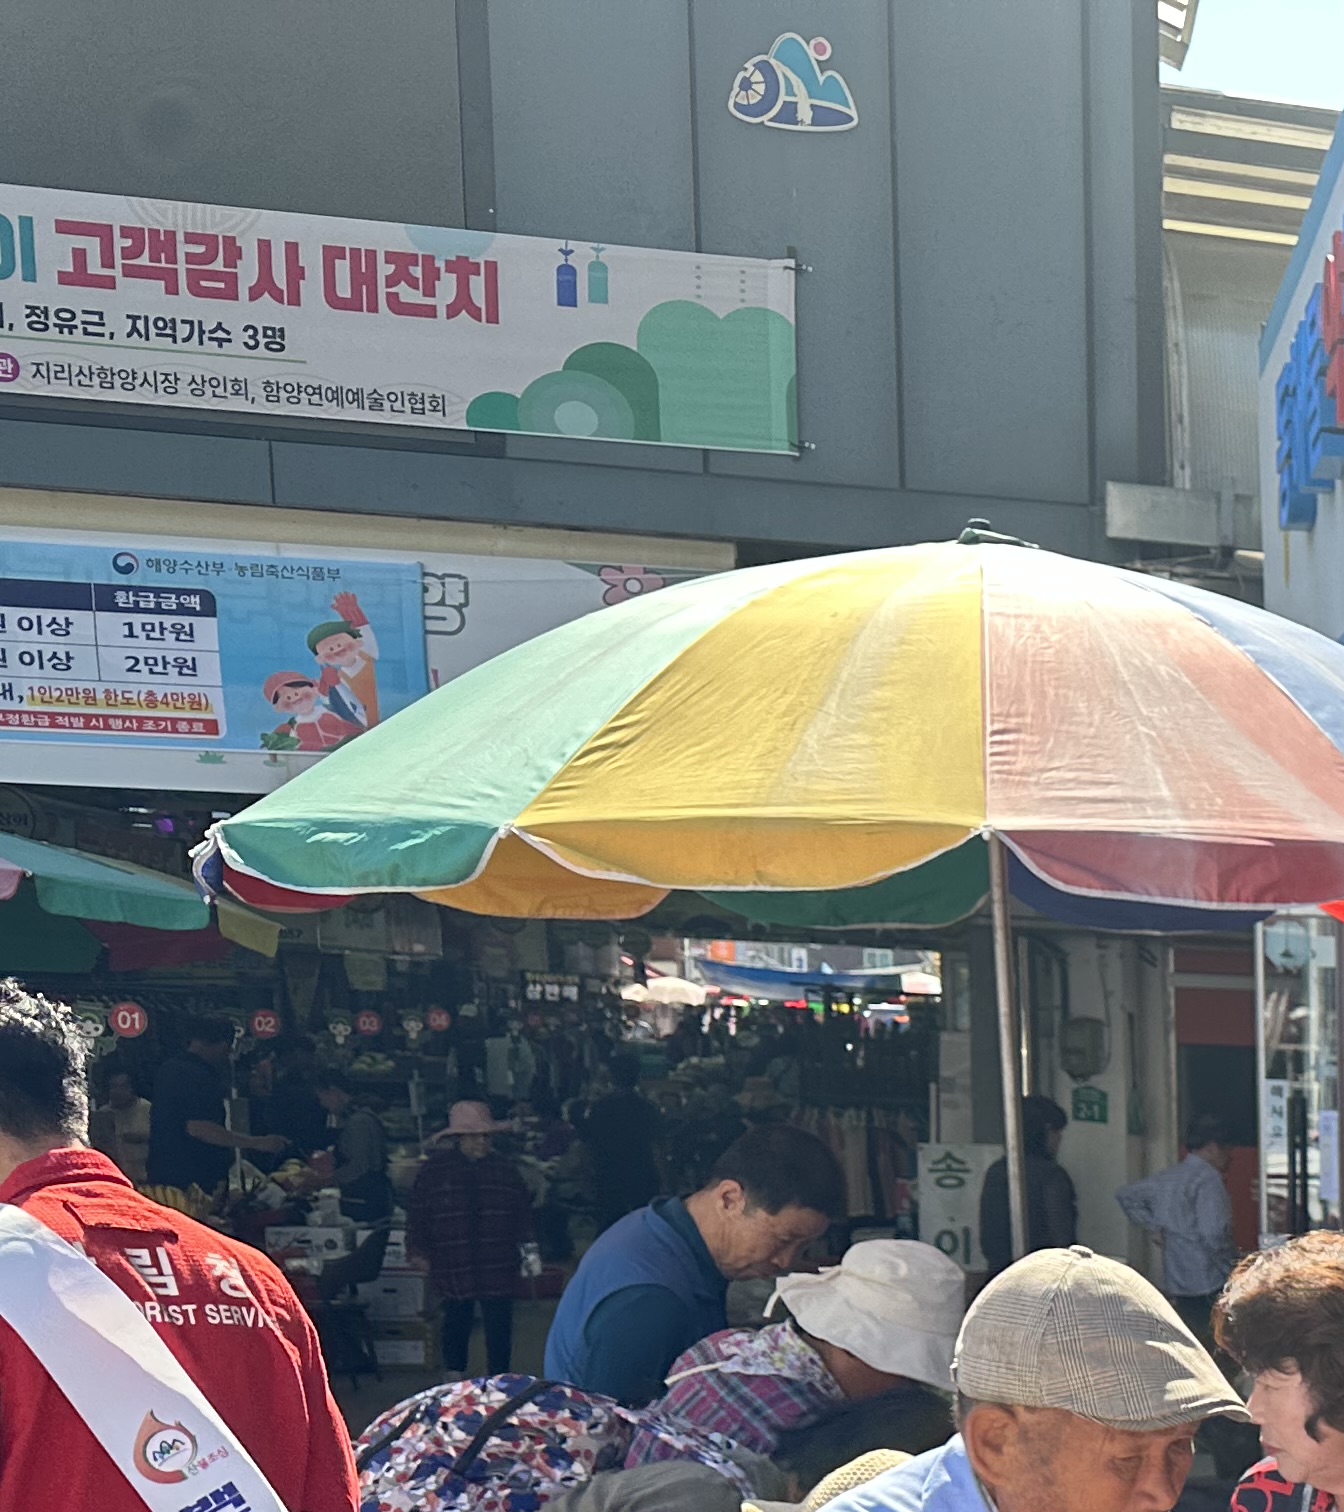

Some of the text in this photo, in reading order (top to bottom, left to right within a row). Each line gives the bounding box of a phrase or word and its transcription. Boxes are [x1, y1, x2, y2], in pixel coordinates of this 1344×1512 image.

[54, 218, 306, 307] 고객감사
[321, 244, 500, 325] 대잔치
[24, 304, 116, 341] 정유근,
[125, 313, 233, 349] 지역가수
[242, 324, 287, 353] 3명
[30, 360, 181, 395] 지리산함양시장
[187, 373, 257, 405] 상인회,
[261, 379, 447, 417] 함양연예예술인협회
[113, 589, 202, 611] 환급금액
[16, 614, 74, 637] 이상
[121, 620, 196, 643] 1만원
[17, 649, 75, 672] 이상
[124, 654, 199, 677] 2만원
[27, 684, 98, 707] 1인2만원
[102, 688, 210, 712] 한도(총4만원)
[55, 714, 85, 729] 적발
[90, 716, 104, 730] 시
[108, 716, 139, 731] 행사
[142, 718, 172, 733] 조기
[176, 719, 207, 734] 종료
[116, 1009, 141, 1030] 01
[254, 1015, 275, 1034] 02
